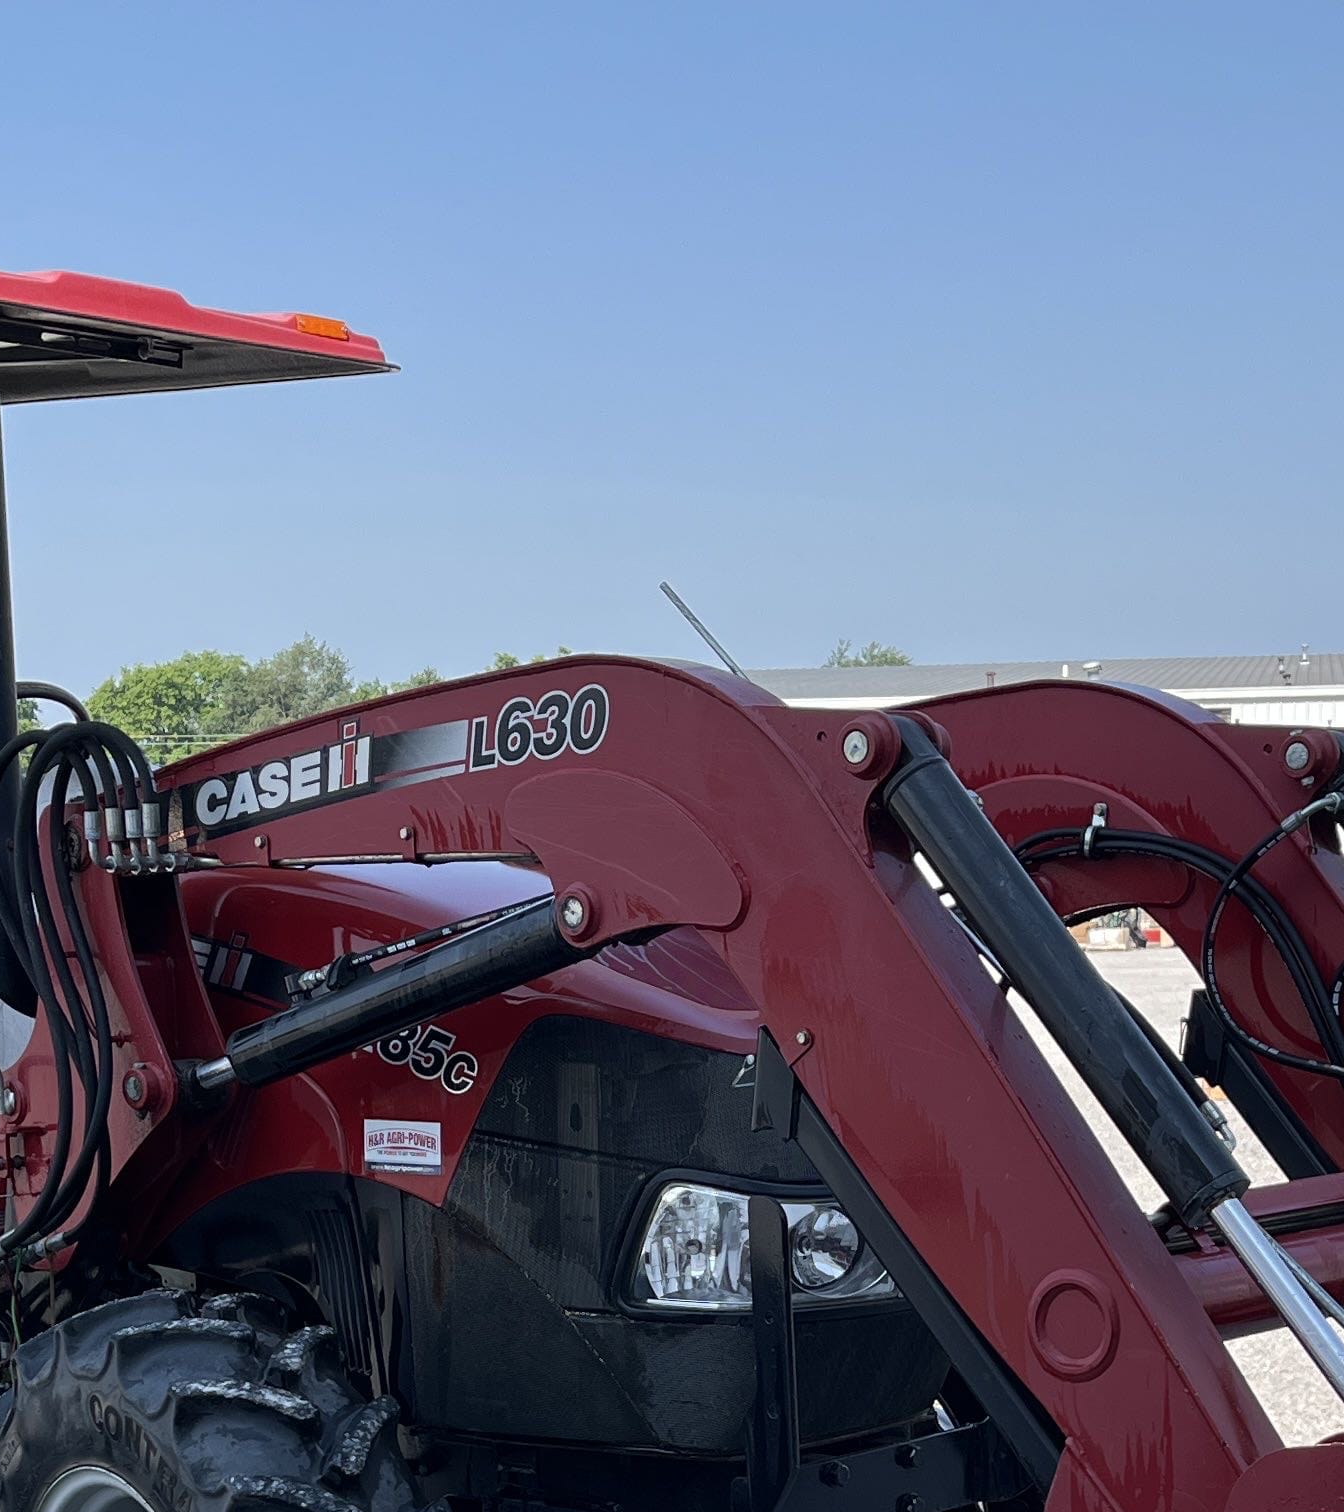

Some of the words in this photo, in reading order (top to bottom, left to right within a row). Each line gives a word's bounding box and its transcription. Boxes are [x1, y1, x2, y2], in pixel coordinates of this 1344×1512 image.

[468, 683, 610, 773] L630
[195, 750, 321, 827] CASE
[376, 1025, 478, 1094] 85C
